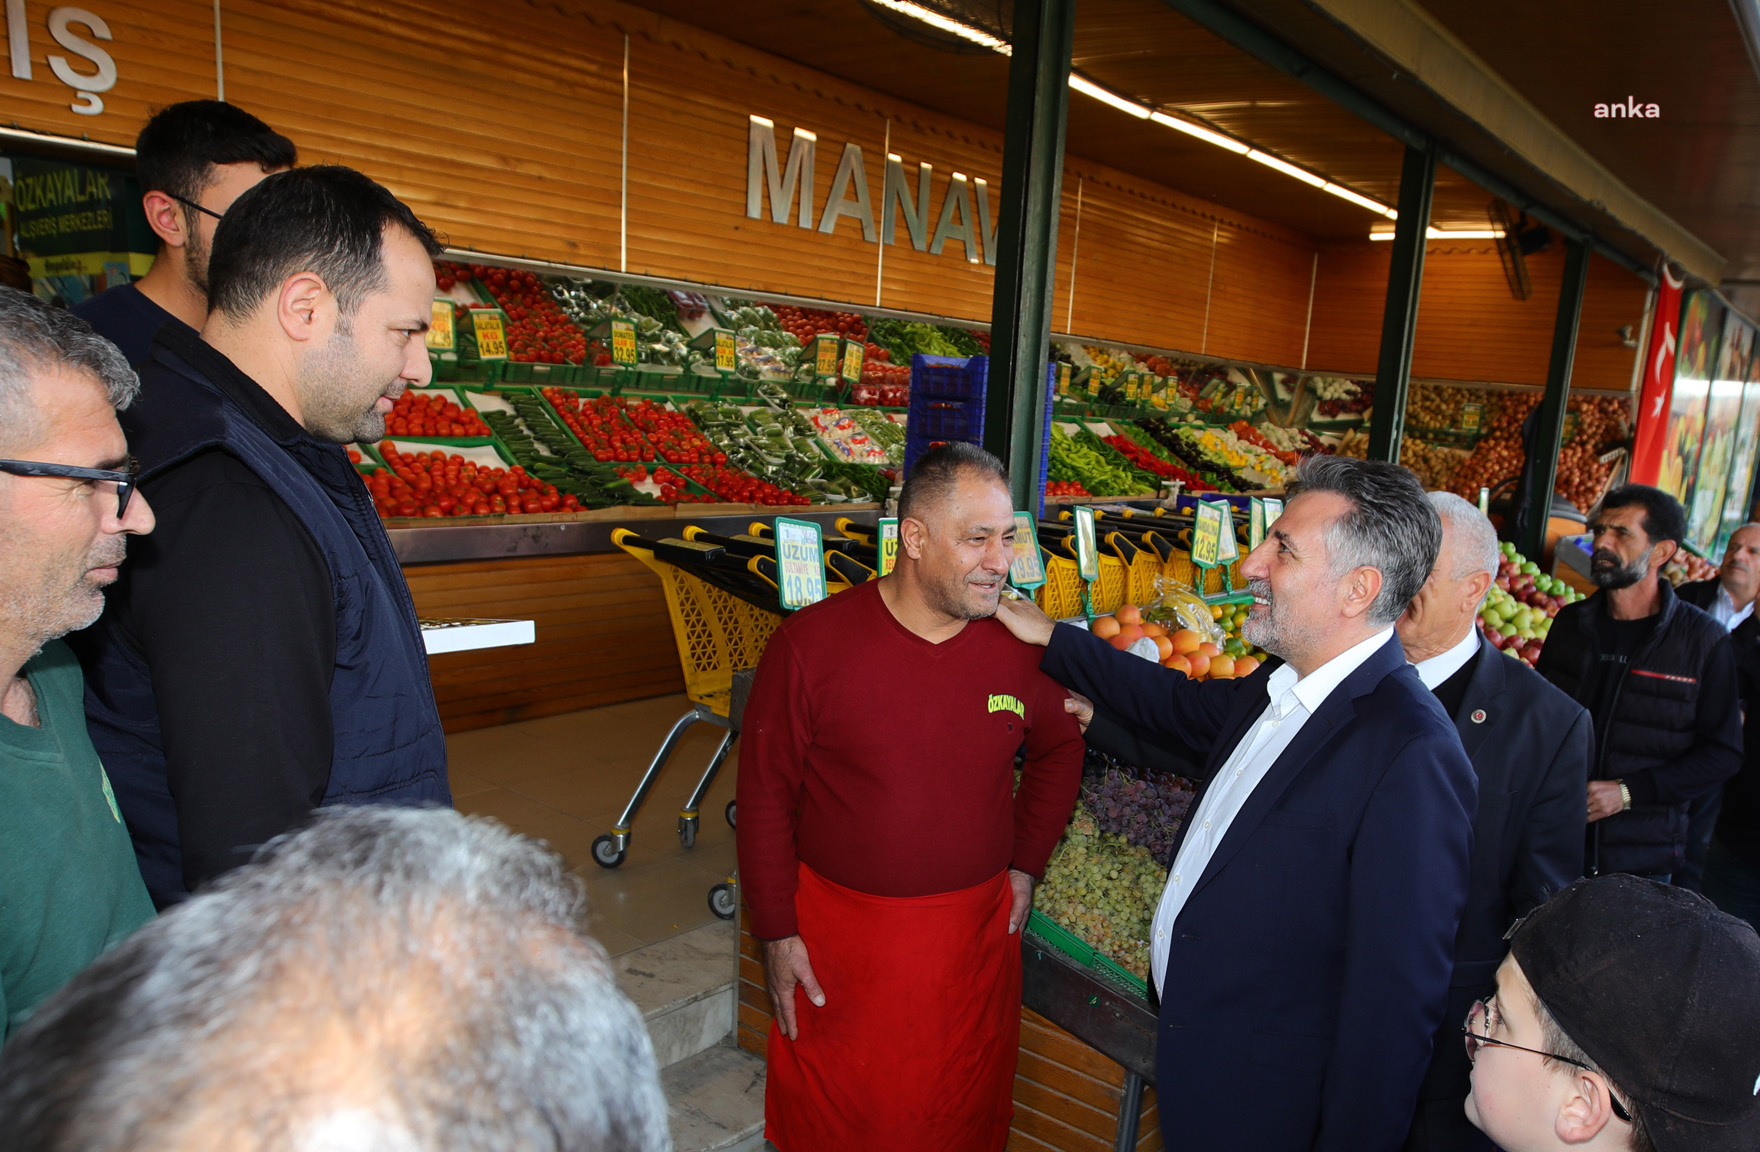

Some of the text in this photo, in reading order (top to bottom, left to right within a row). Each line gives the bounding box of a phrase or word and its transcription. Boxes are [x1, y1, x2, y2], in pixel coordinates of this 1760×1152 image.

[15, 168, 112, 212] ÖZKAYALAR
[747, 114, 998, 266] MANAV
[482, 331, 498, 340] KG
[613, 330, 634, 340] DOMATES
[480, 341, 505, 354] 14.95
[613, 346, 635, 364] 32.95
[716, 354, 734, 367] 17.95
[817, 358, 835, 373] 27.95
[888, 527, 893, 536] 1
[782, 540, 820, 562] ÜZÜM
[1195, 537, 1216, 562] 12.95
[1012, 556, 1040, 579] 19.95
[786, 575, 822, 605] 18.95
[987, 693, 1025, 720] ÖZKAYALAR
